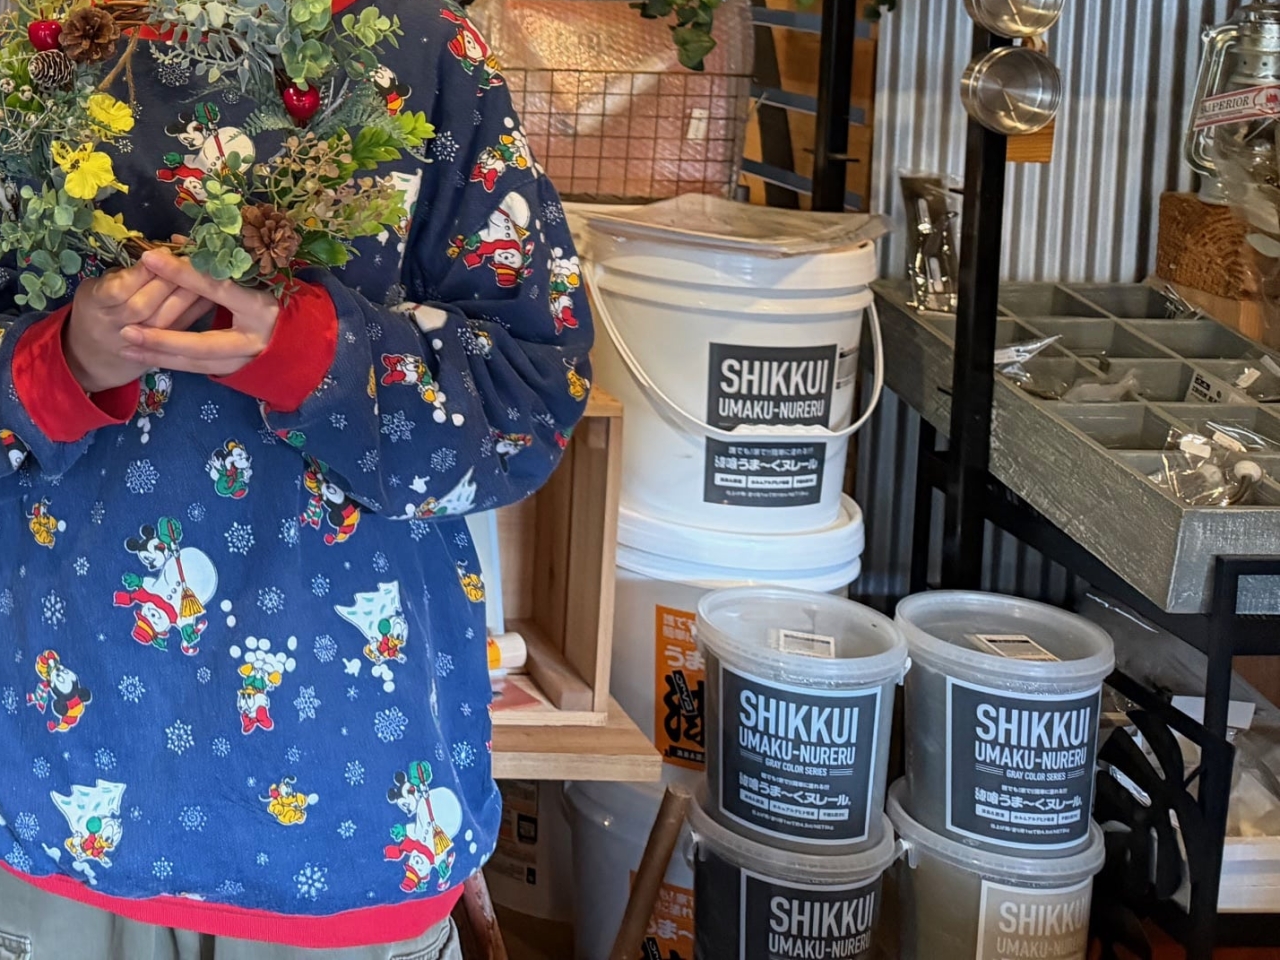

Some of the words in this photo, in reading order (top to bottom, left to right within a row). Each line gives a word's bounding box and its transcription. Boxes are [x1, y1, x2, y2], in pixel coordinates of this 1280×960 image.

[720, 358, 829, 396] SHIKKUI
[718, 397, 825, 420] UMAKU-NURERU
[739, 689, 859, 744] SHIKKUI
[976, 703, 1090, 748] SHIKKUI
[739, 726, 856, 765] UMAKU-NURERU
[975, 740, 1087, 770] UMAKU-NURERU
[765, 757, 781, 770] GRAY
[782, 762, 804, 774] COLOR
[804, 766, 828, 777] SERIES
[1006, 769, 1024, 780] GRAY
[1024, 771, 1046, 781] COLOR
[1046, 772, 1066, 781] SERIES
[769, 891, 875, 938] SHIKKUI
